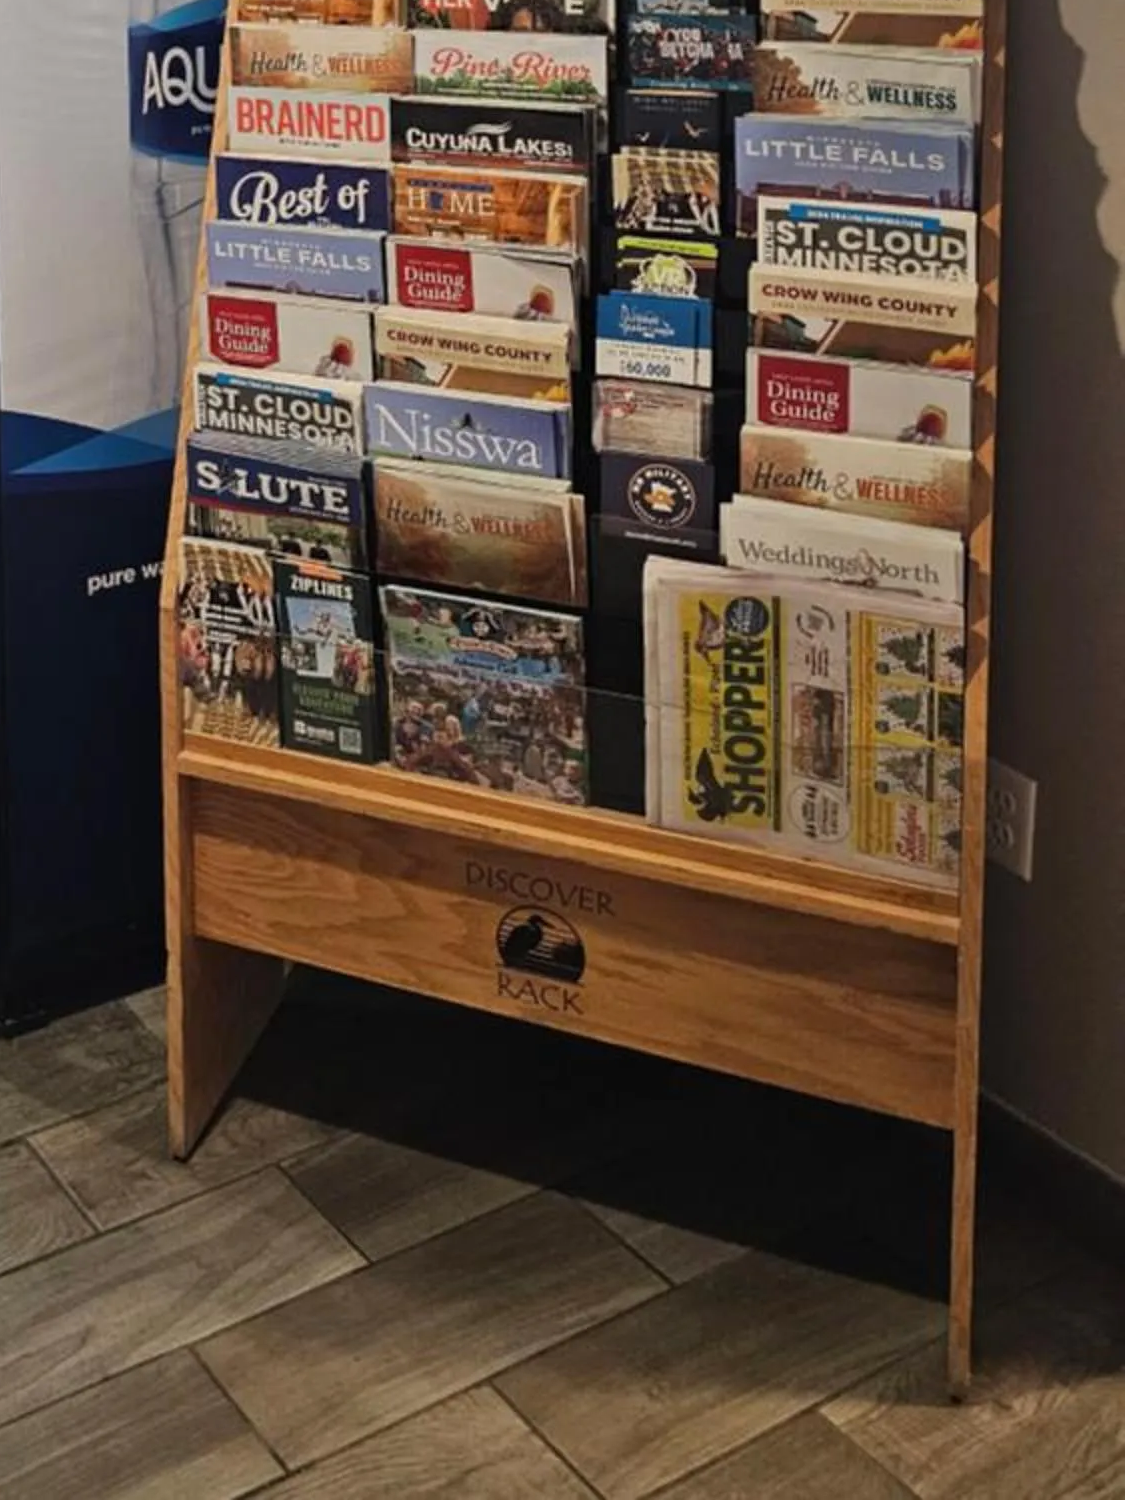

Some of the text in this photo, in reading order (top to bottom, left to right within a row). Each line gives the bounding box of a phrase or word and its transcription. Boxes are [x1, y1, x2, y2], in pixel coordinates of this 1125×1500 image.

[251, 51, 307, 74] Health
[430, 47, 591, 88] Pine River
[767, 73, 957, 111] Health & WELLNESS
[236, 96, 386, 143] BRAINERD
[405, 127, 567, 157] CUYUNA LAKES
[744, 139, 842, 162] LITTLE
[852, 146, 946, 171] FALLS
[230, 170, 370, 224] Best of
[408, 186, 496, 217] HME
[214, 240, 291, 263] LITTLE
[298, 249, 372, 272] FALLS
[776, 220, 830, 248] ST.
[837, 225, 966, 261] CLOUD
[403, 265, 466, 290] Dining
[776, 246, 966, 283] MINNESOTA
[407, 283, 464, 300] Guide
[762, 283, 818, 301] CROW
[822, 290, 873, 308] WING
[878, 297, 958, 318] COUNTY
[215, 316, 272, 342] Dining
[218, 333, 269, 353] Guide
[386, 329, 552, 363] CROW WING COUNTY
[207, 384, 249, 412] ST.
[254, 393, 354, 429] CLOUD
[766, 379, 840, 410] Dining
[770, 400, 836, 421] Guide
[207, 409, 355, 455] MINNESOTA
[375, 403, 543, 469] Nisswa
[196, 460, 350, 514] SLUTE
[752, 462, 828, 491] Health
[833, 473, 855, 501] &
[386, 498, 449, 528] Health
[87, 567, 136, 596] pure
[290, 573, 353, 600] ZIPLINES
[723, 637, 765, 817] SHOPPER
[465, 861, 616, 917] DISCOVER
[497, 971, 584, 1016] RACK
